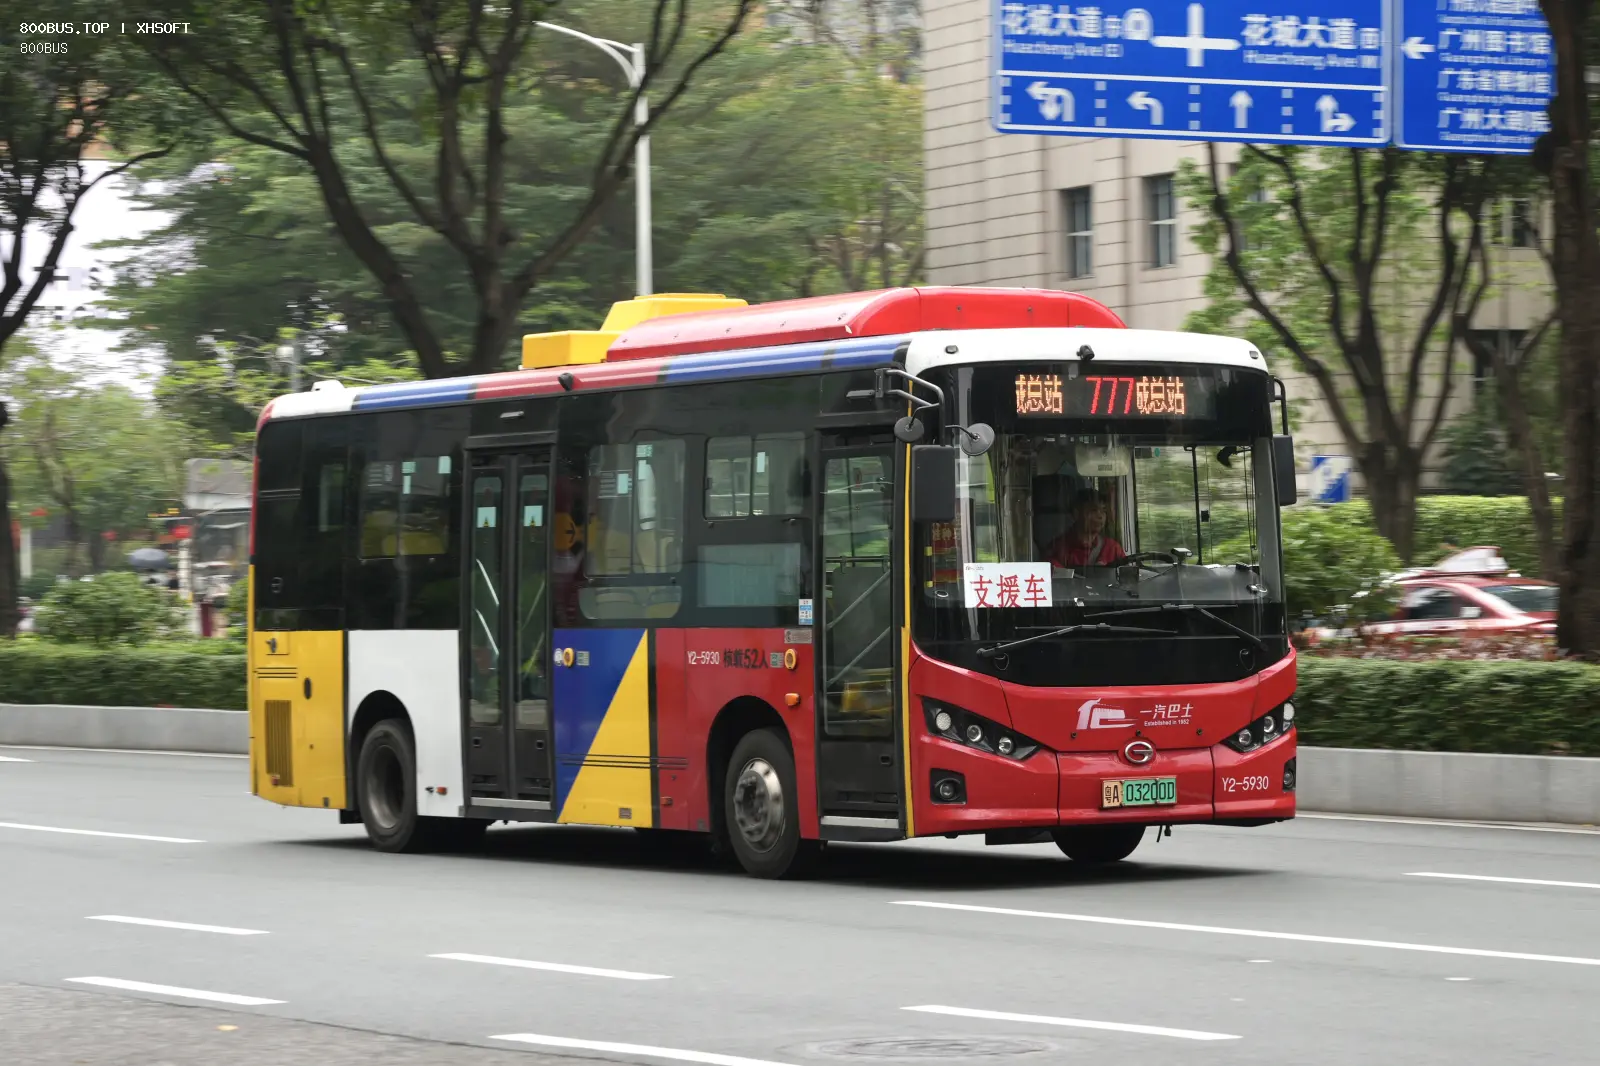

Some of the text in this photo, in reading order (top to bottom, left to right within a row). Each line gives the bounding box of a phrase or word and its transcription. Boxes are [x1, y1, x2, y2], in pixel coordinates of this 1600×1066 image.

[1086, 378, 1134, 414] 777
[970, 574, 1047, 608] 支援车
[687, 651, 719, 664] Y2-5930
[1140, 703, 1194, 719] 一汽巴士
[1222, 776, 1269, 791] Y2-5930
